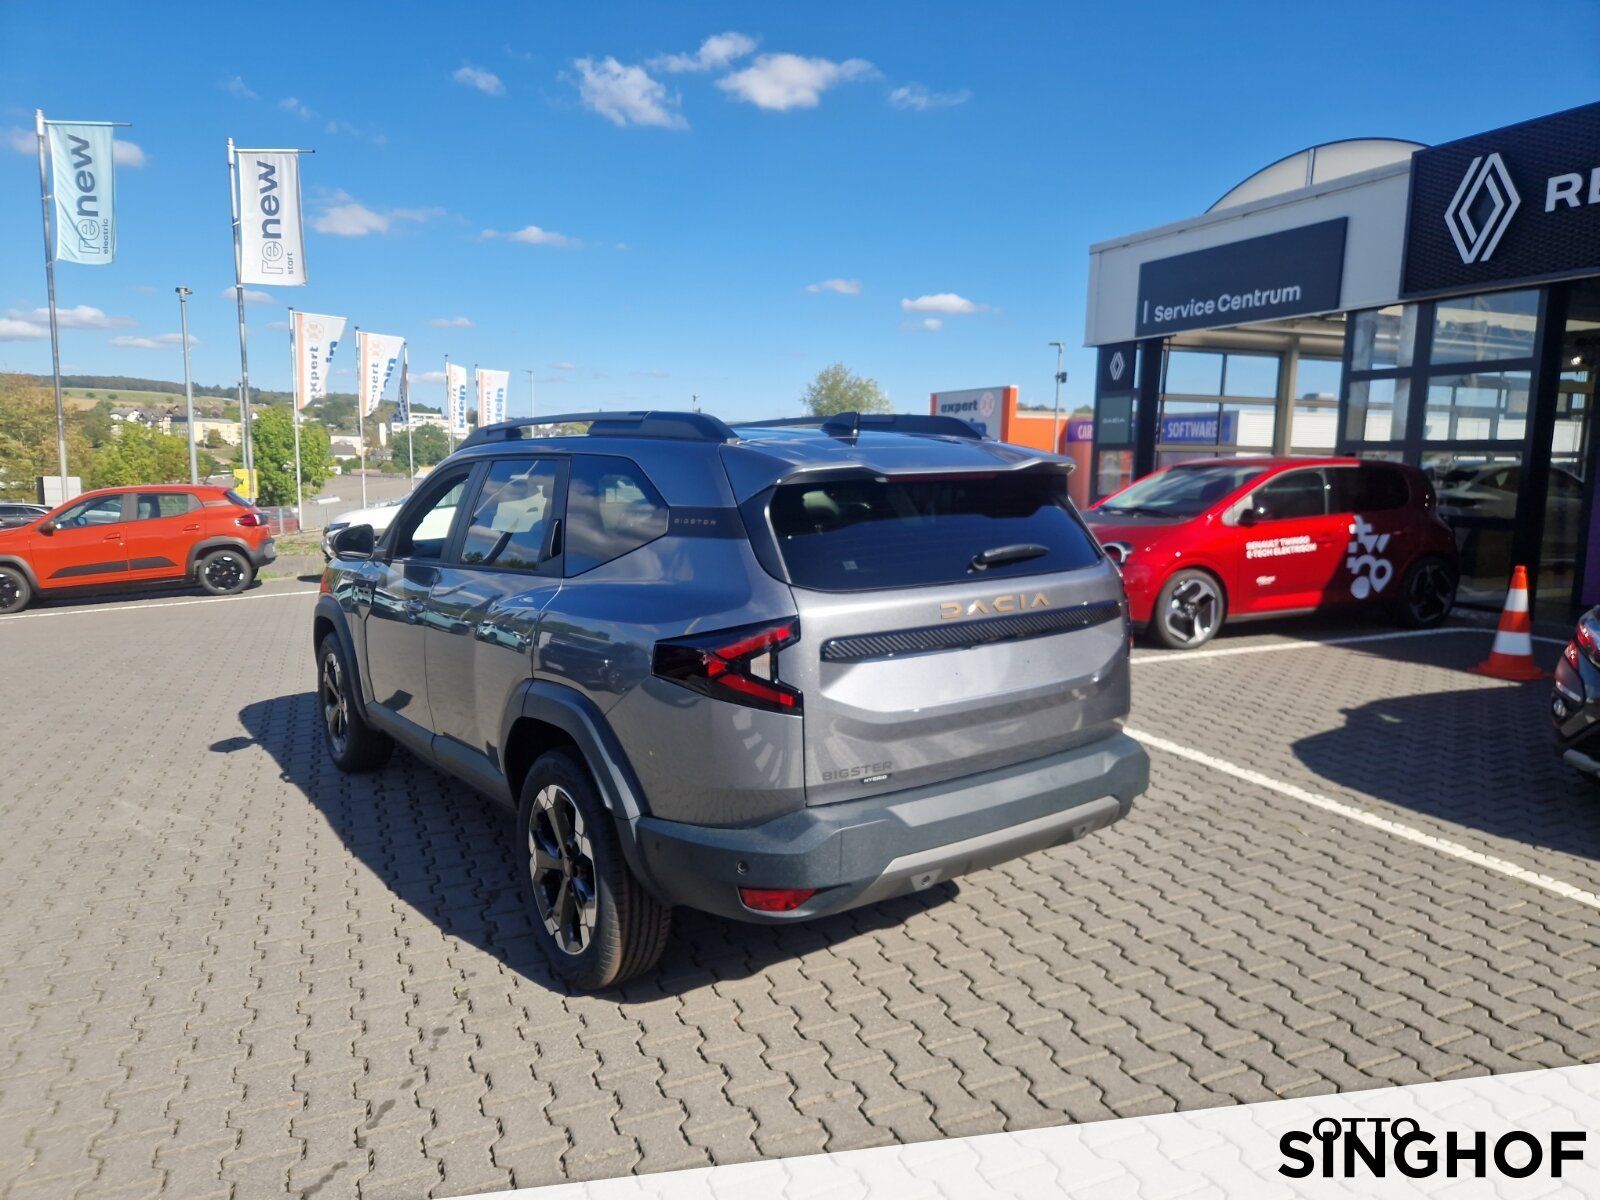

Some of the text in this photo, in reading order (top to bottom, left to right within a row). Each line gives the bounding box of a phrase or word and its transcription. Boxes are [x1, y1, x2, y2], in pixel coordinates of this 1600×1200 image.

[67, 133, 101, 255] renew
[255, 160, 284, 275] renew
[102, 217, 110, 255] electric
[1154, 284, 1302, 323] Service Centrum
[940, 399, 979, 414] expert
[1167, 420, 1218, 439] SOFTWARE
[939, 591, 1052, 620] DACIA
[822, 760, 893, 781] BIGSTER
[863, 774, 888, 784] HYBRID
